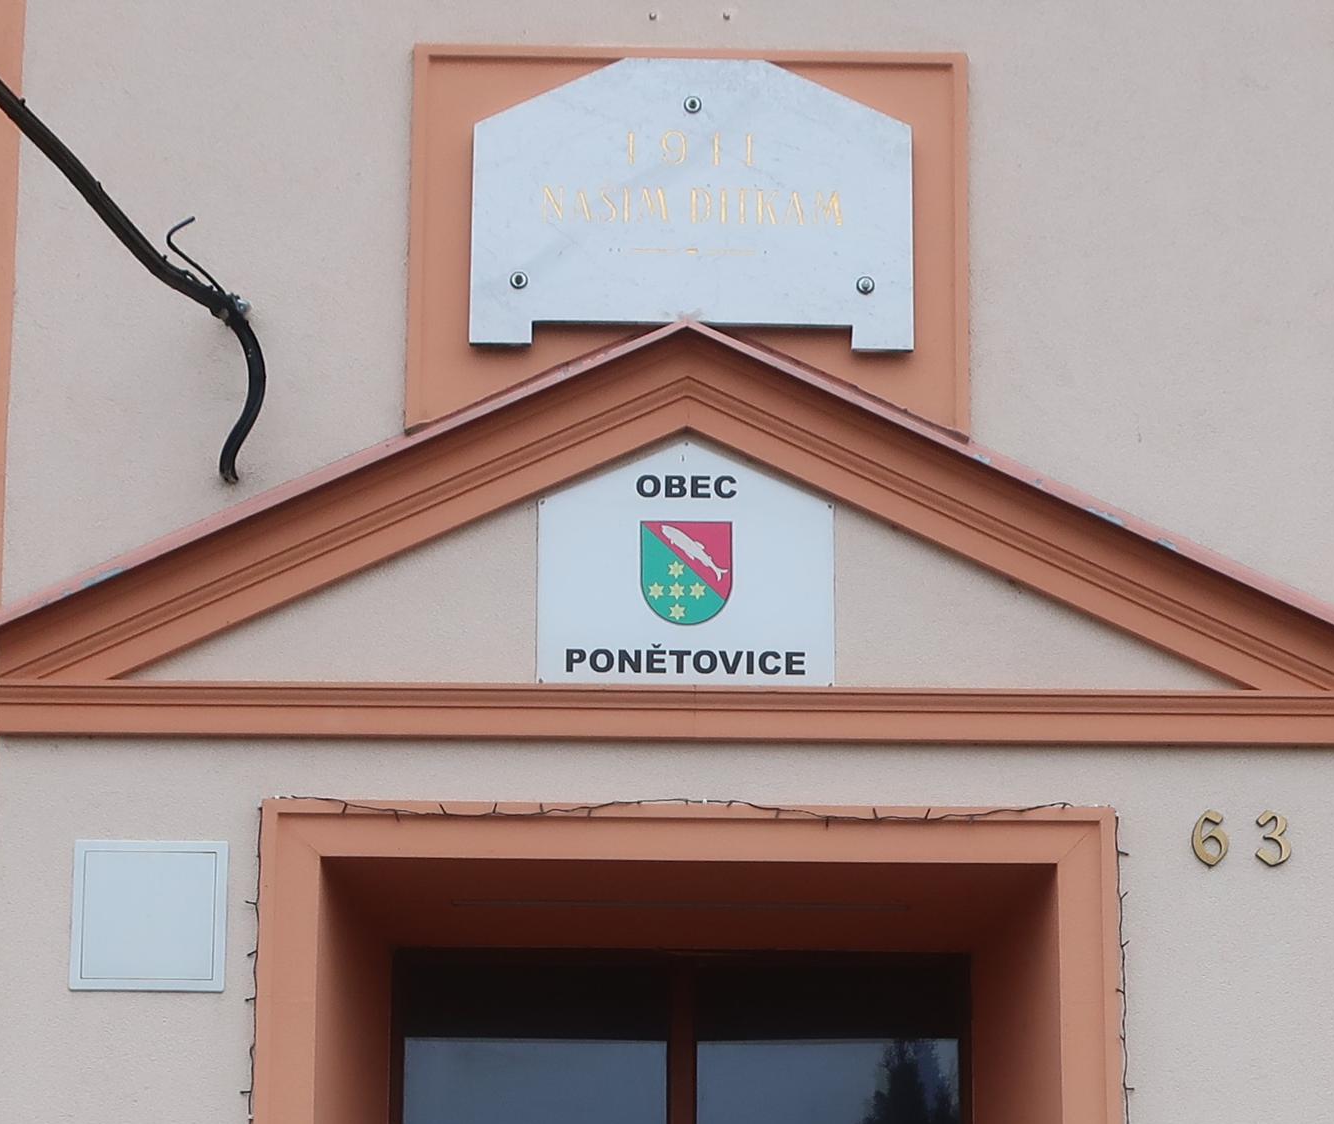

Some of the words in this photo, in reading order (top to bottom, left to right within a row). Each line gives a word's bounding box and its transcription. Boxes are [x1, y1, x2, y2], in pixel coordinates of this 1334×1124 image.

[625, 130, 756, 167] 1911
[636, 474, 738, 499] OBEC
[565, 643, 806, 675] PONĚTOVICE
[1192, 809, 1292, 868] 63
